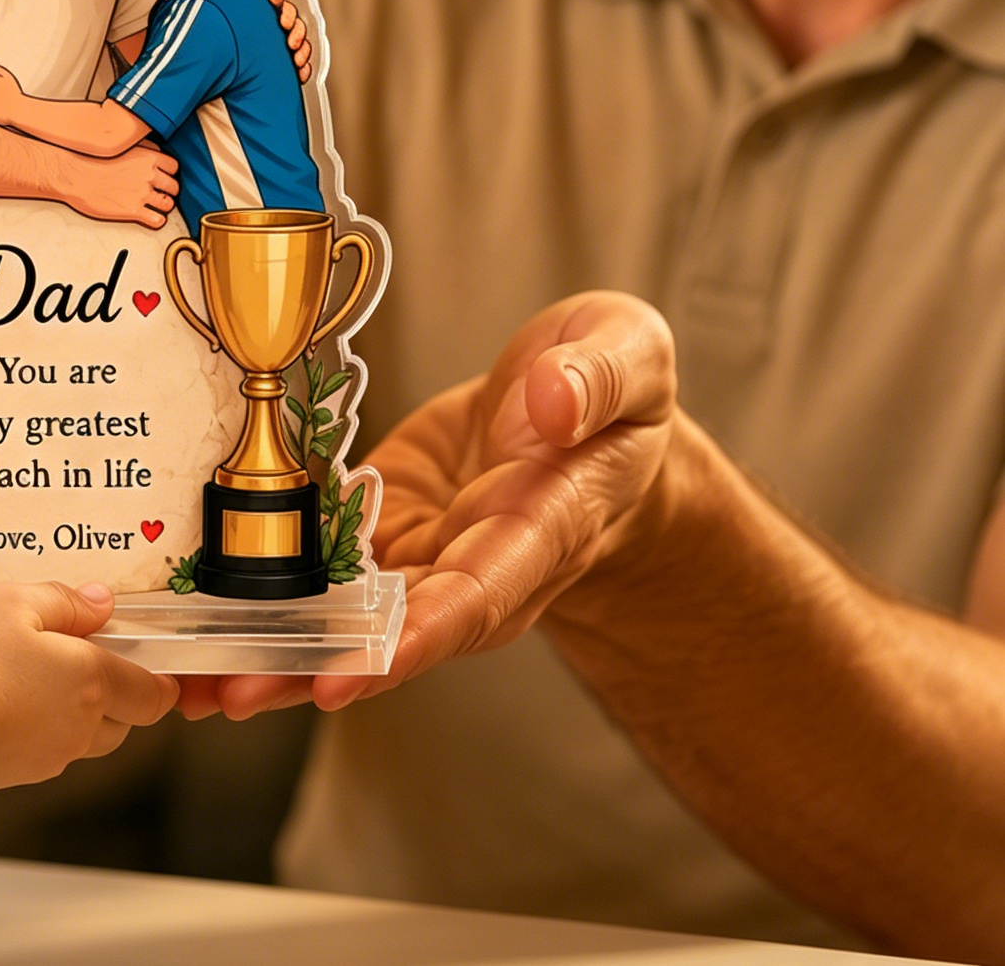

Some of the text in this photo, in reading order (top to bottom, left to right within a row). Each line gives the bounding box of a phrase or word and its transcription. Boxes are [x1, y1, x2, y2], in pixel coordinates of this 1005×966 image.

[69, 364, 117, 384] are
[25, 411, 151, 446] greatest
[63, 459, 93, 488] in
[104, 458, 152, 488] life
[53, 523, 135, 551] Oliver
